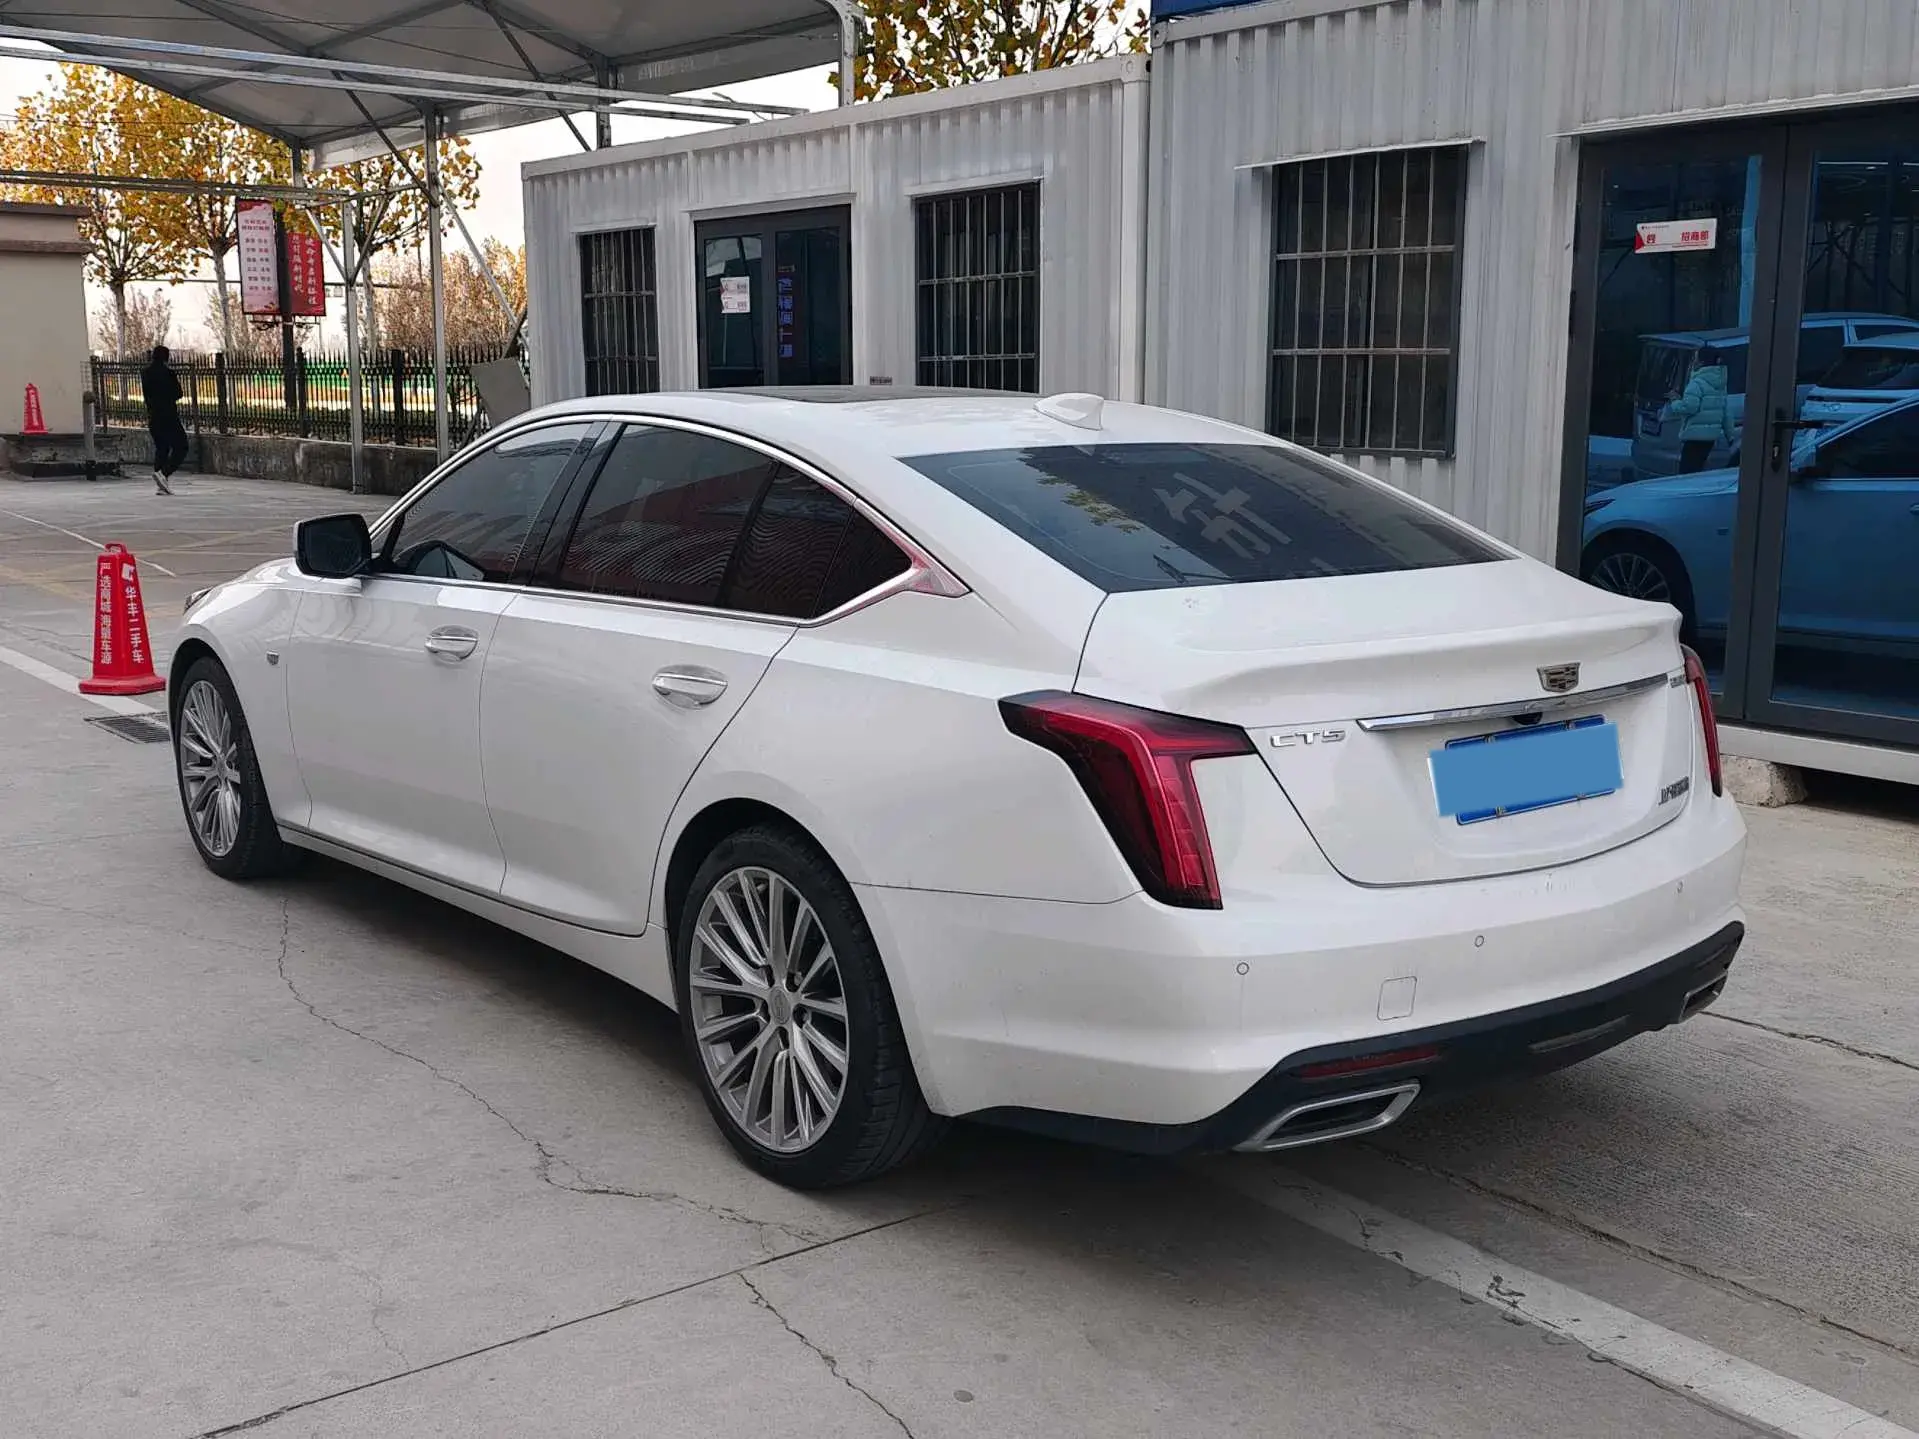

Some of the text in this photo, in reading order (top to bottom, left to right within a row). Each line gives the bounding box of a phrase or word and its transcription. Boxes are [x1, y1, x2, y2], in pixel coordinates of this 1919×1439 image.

[1681, 230, 1709, 242] 招商部
[1269, 729, 1347, 749] CT5
